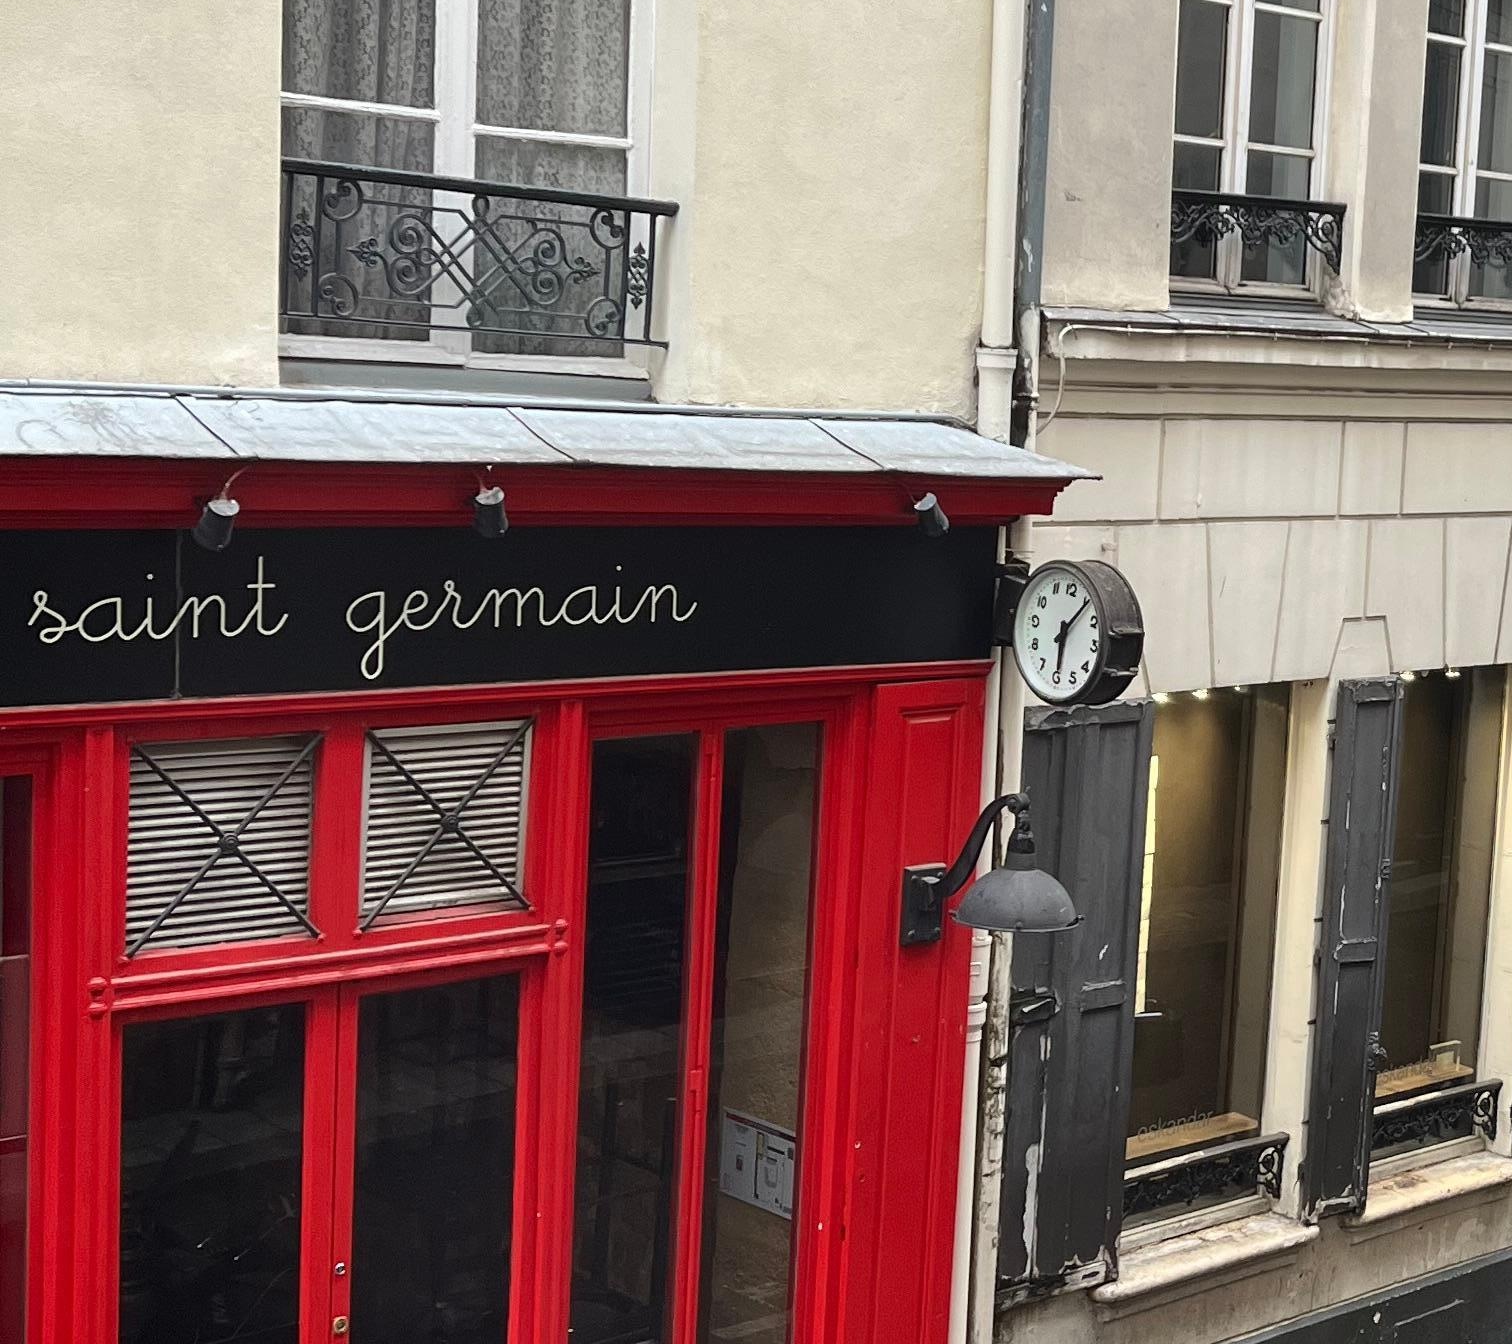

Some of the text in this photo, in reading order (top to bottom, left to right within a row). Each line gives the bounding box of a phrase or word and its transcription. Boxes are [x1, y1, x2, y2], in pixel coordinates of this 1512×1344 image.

[1066, 583, 1077, 597] 12
[1037, 596, 1047, 609] 10
[27, 556, 697, 679] saint germain
[1031, 615, 1040, 628] 9
[1090, 616, 1098, 629] 2
[1031, 638, 1039, 651] 8
[1090, 639, 1099, 653] 3
[1040, 658, 1046, 671] 7
[1081, 660, 1089, 673] 4
[1052, 671, 1060, 684] 6
[1069, 671, 1077, 684] 5
